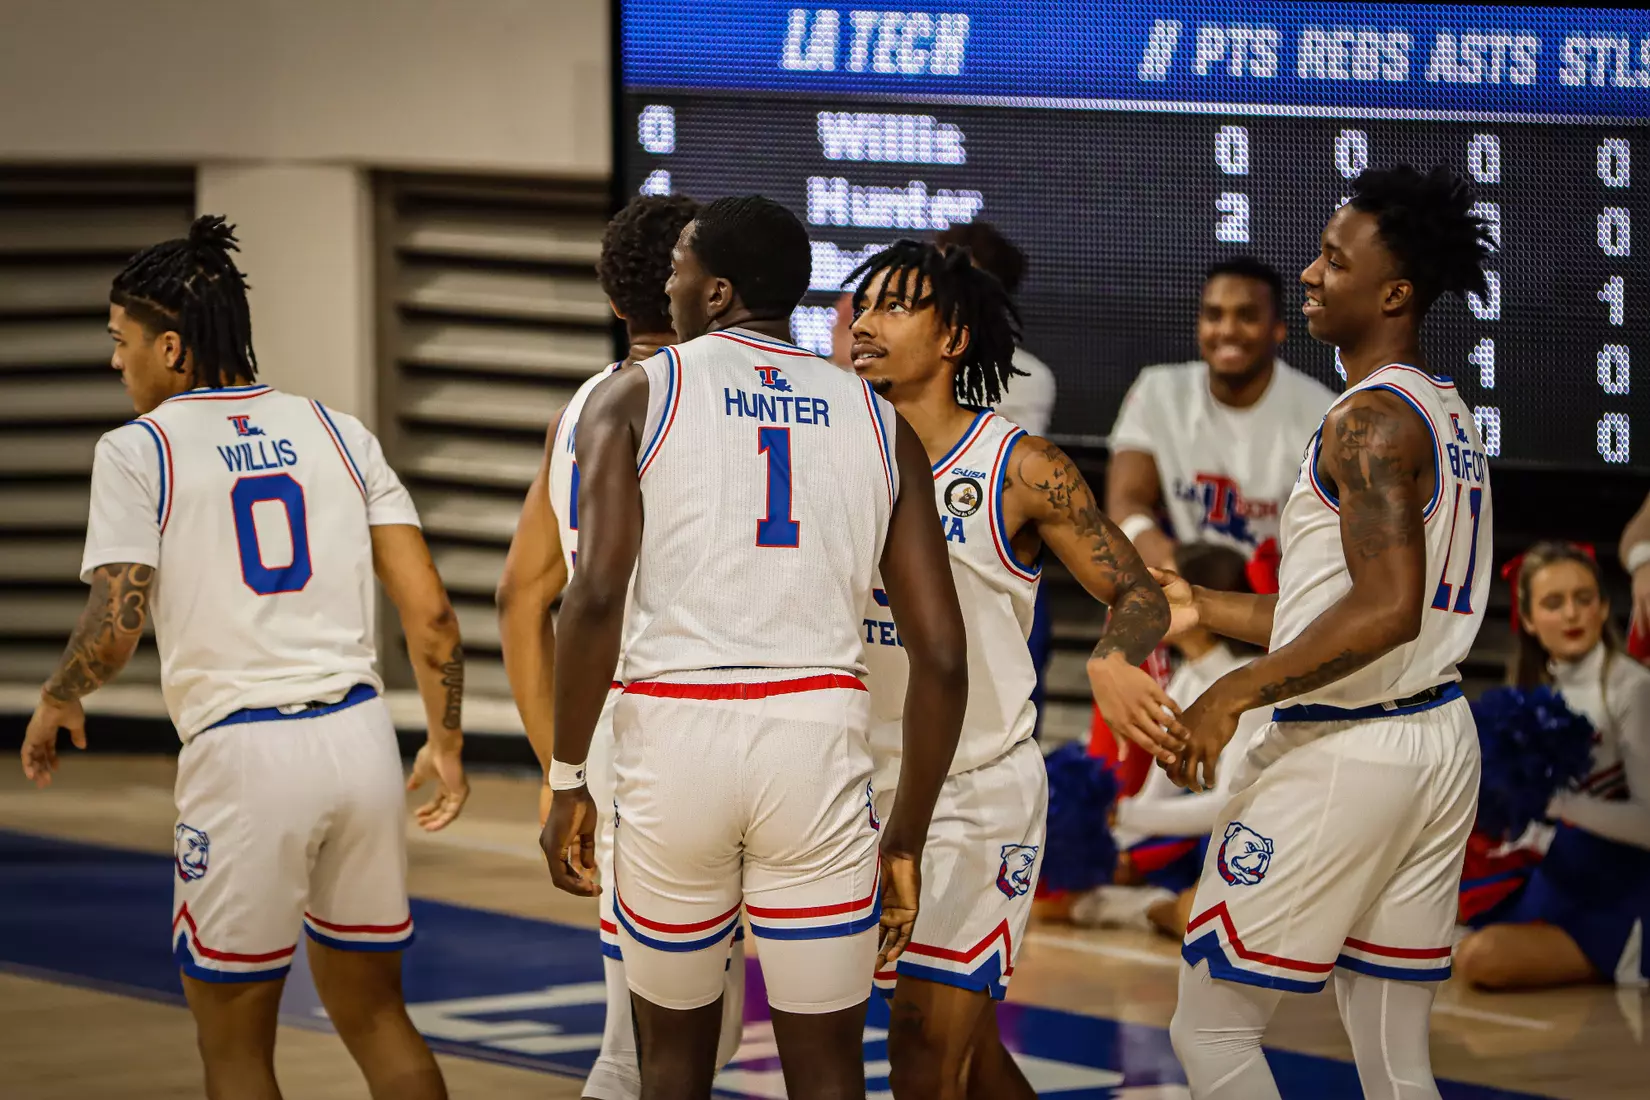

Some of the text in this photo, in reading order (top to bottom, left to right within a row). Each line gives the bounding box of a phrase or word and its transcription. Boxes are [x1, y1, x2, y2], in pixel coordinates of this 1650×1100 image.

[779, 9, 970, 75] LA TECH
[1192, 22, 1282, 78] PTS
[1297, 25, 1411, 81] REBS
[1425, 28, 1541, 84] ASTS
[638, 105, 675, 153] 0
[1215, 125, 1248, 175] 0
[1334, 129, 1368, 178] 0
[1467, 134, 1500, 183] 0
[1597, 138, 1630, 187] 0
[807, 176, 983, 230] Hunter
[1597, 207, 1630, 256] 0
[1597, 275, 1624, 325] 1
[1468, 338, 1630, 394] 1 0
[724, 387, 830, 428] HUNTER
[1597, 412, 1630, 462] 0
[216, 439, 298, 472] WILLIS
[756, 426, 800, 548] 1
[230, 473, 313, 596] 0
